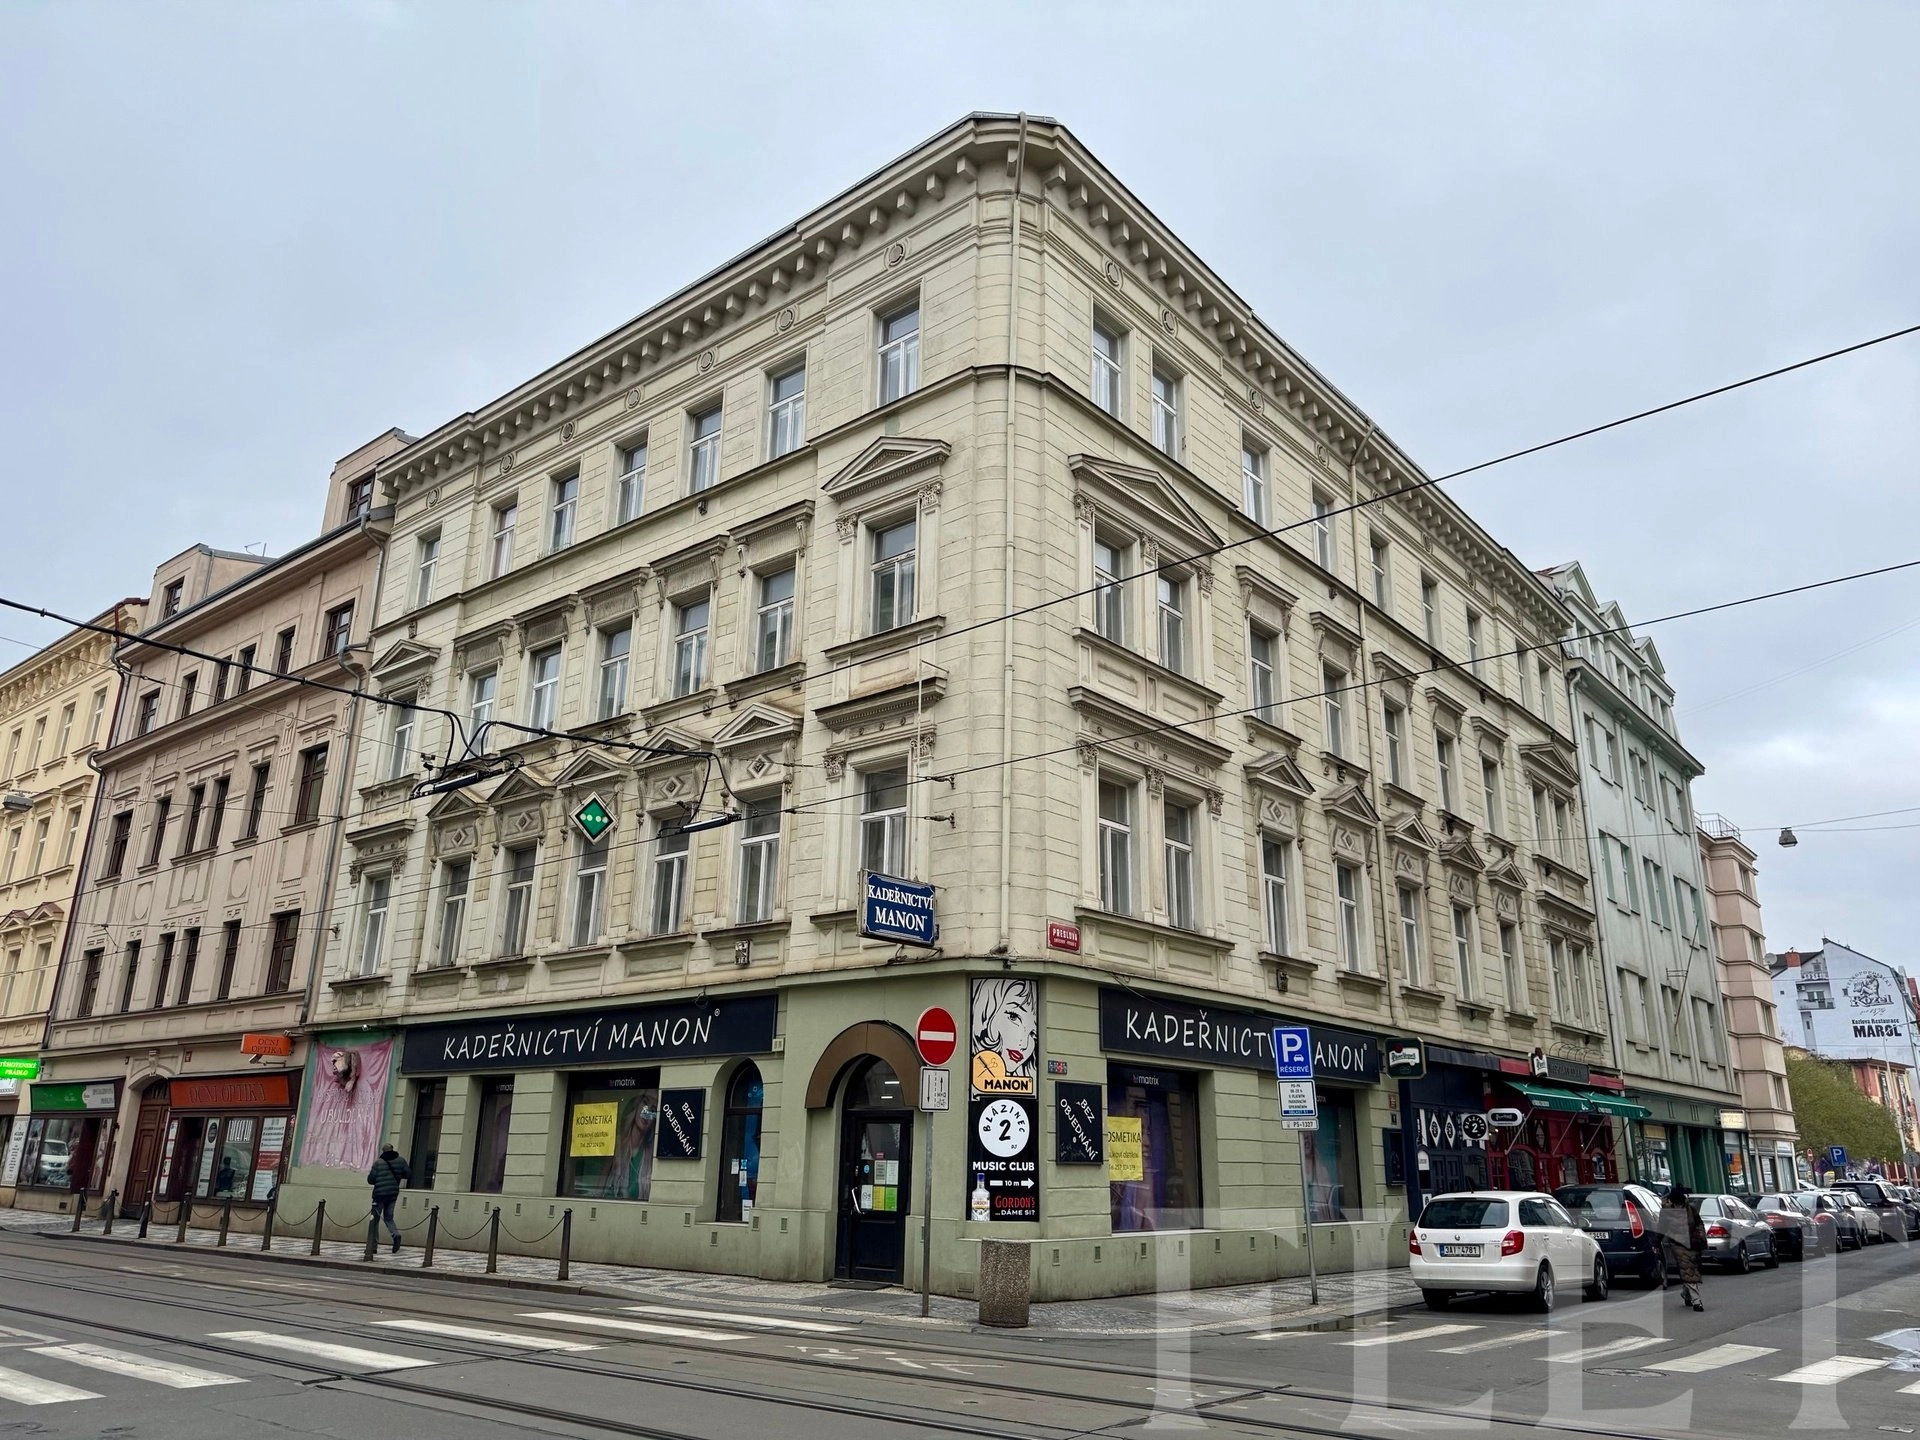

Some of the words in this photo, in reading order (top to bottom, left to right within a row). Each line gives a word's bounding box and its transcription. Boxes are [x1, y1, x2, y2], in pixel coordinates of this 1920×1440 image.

[868, 885, 933, 910] KADEŘNICTVÍ
[443, 1018, 603, 1060] KADEŘNICTVÍ
[1126, 1008, 1275, 1059] KADEŘNICT
[1281, 1034, 1302, 1062] P
[1138, 1075, 1159, 1086] matrix
[576, 1115, 613, 1126] KOSMETIKA
[681, 1102, 696, 1123] BEZ
[983, 1104, 1026, 1132] BLÁZINEC
[1080, 1099, 1095, 1123] BEZ
[662, 1104, 696, 1155] OBJEDNÁNÍ
[999, 1119, 1011, 1141] 2
[1060, 1098, 1099, 1160] OBJEDNÁNÍ
[1107, 1131, 1142, 1143] OSMETIKA
[1471, 1122, 1478, 1133] 2
[1833, 1148, 1843, 1160] P
[973, 1161, 1007, 1171] MUSIC
[1009, 1161, 1035, 1171] CLUB
[1461, 1246, 1478, 1254] 4781
